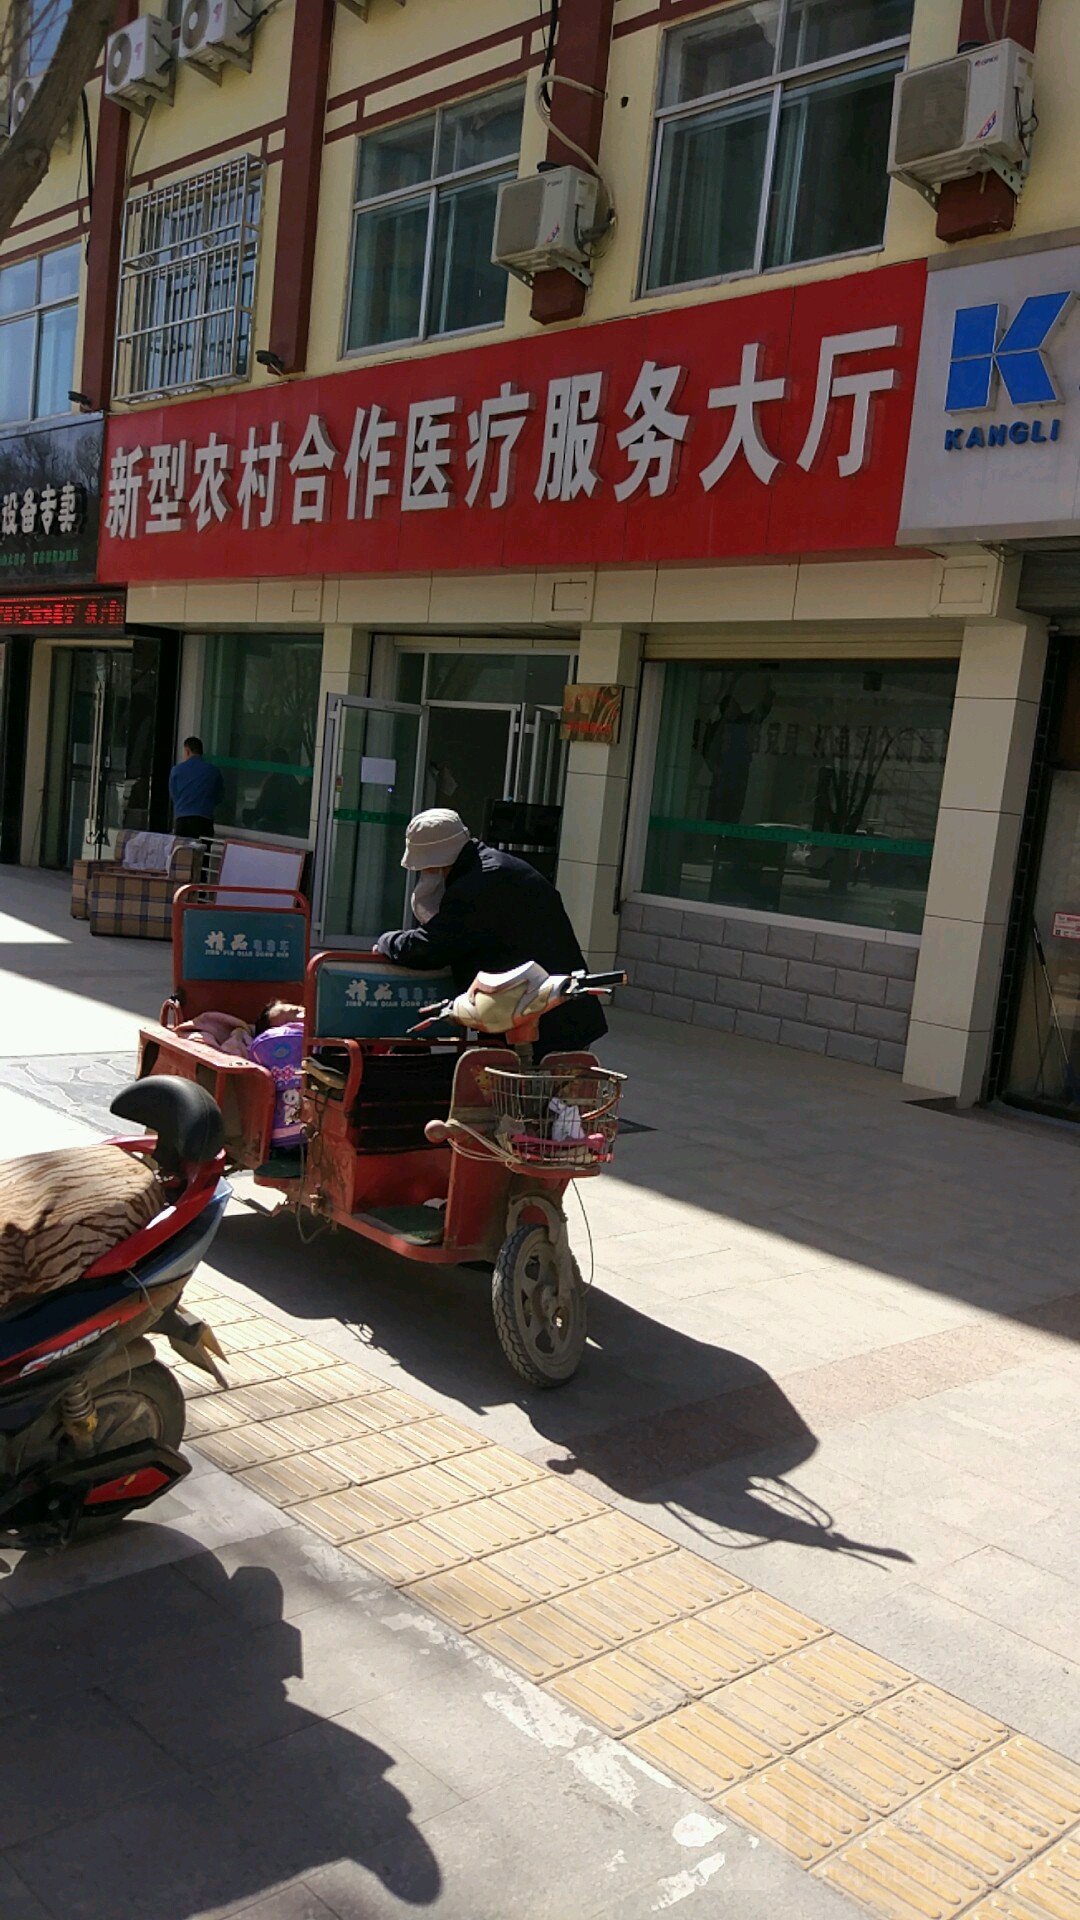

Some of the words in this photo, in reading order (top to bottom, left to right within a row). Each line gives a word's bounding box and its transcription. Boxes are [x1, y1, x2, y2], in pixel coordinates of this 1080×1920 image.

[105, 324, 899, 540] 新型农村合作医疗服务大厅
[944, 418, 1061, 452] KANGLI
